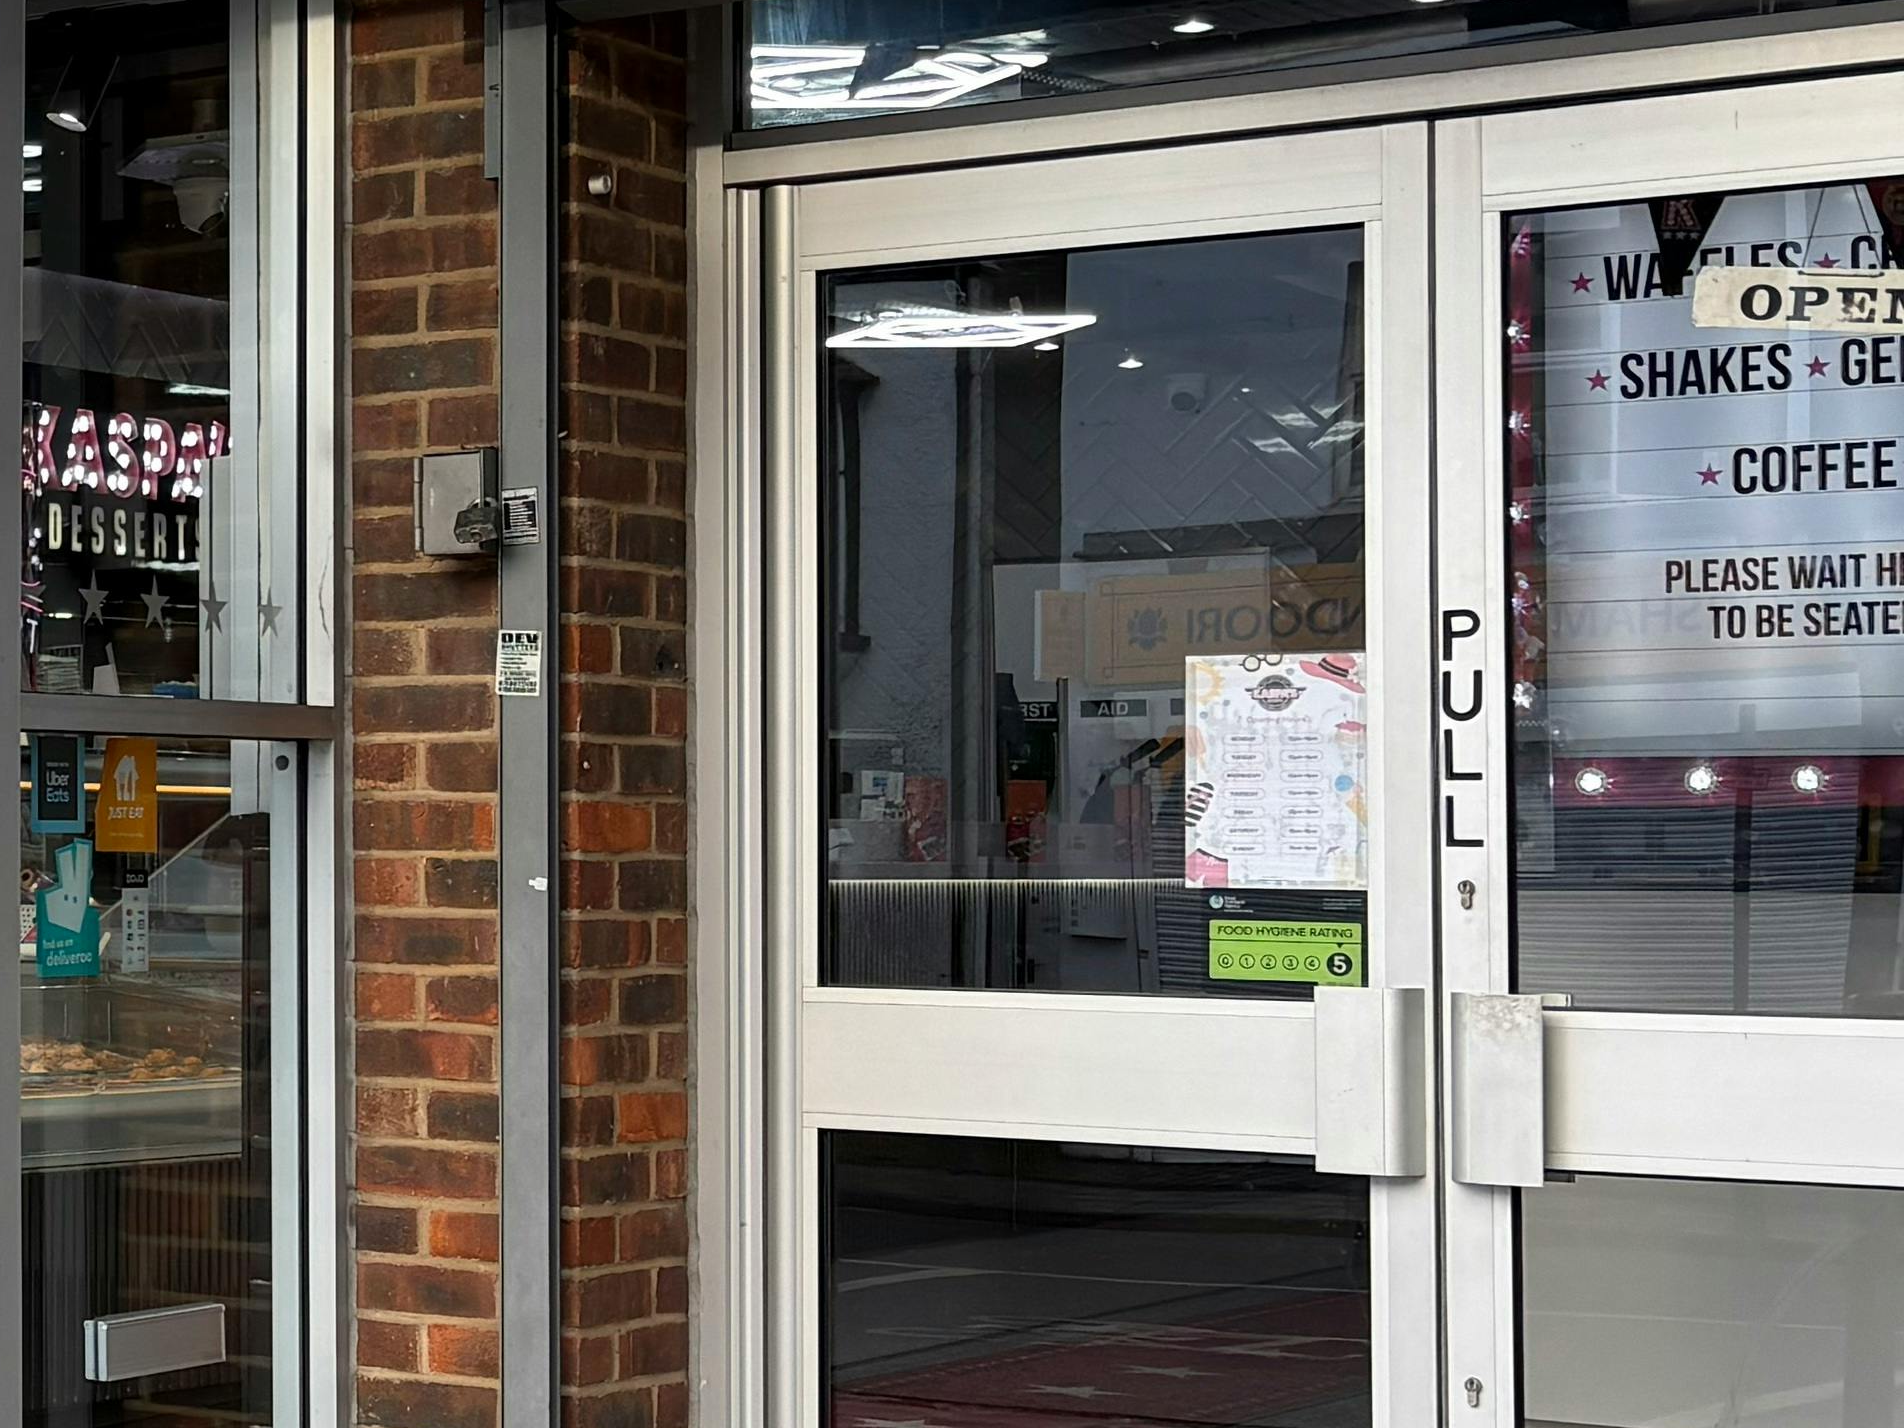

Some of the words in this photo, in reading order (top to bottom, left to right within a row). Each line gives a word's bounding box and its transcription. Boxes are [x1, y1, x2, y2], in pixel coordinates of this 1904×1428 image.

[1619, 343, 1792, 399] SHAKES
[1841, 336, 1904, 386] GE
[1732, 441, 1897, 494] COFFEE
[48, 503, 200, 561] DESSERT
[1665, 557, 1779, 593] PLEASE
[1788, 554, 1866, 589] WAIT
[1707, 606, 1745, 638] TO
[1756, 604, 1794, 637] BE
[1804, 601, 1904, 636] SEATE
[1098, 702, 1128, 716] AID
[1442, 609, 1484, 848] PULL
[46, 771, 69, 786] Uber
[46, 787, 70, 802] Eats
[108, 807, 128, 820] JUST
[1218, 926, 1253, 936] FOOD
[1256, 926, 1306, 937] HYGIENE
[1310, 928, 1352, 938] RATING
[1333, 956, 1347, 973] 5
